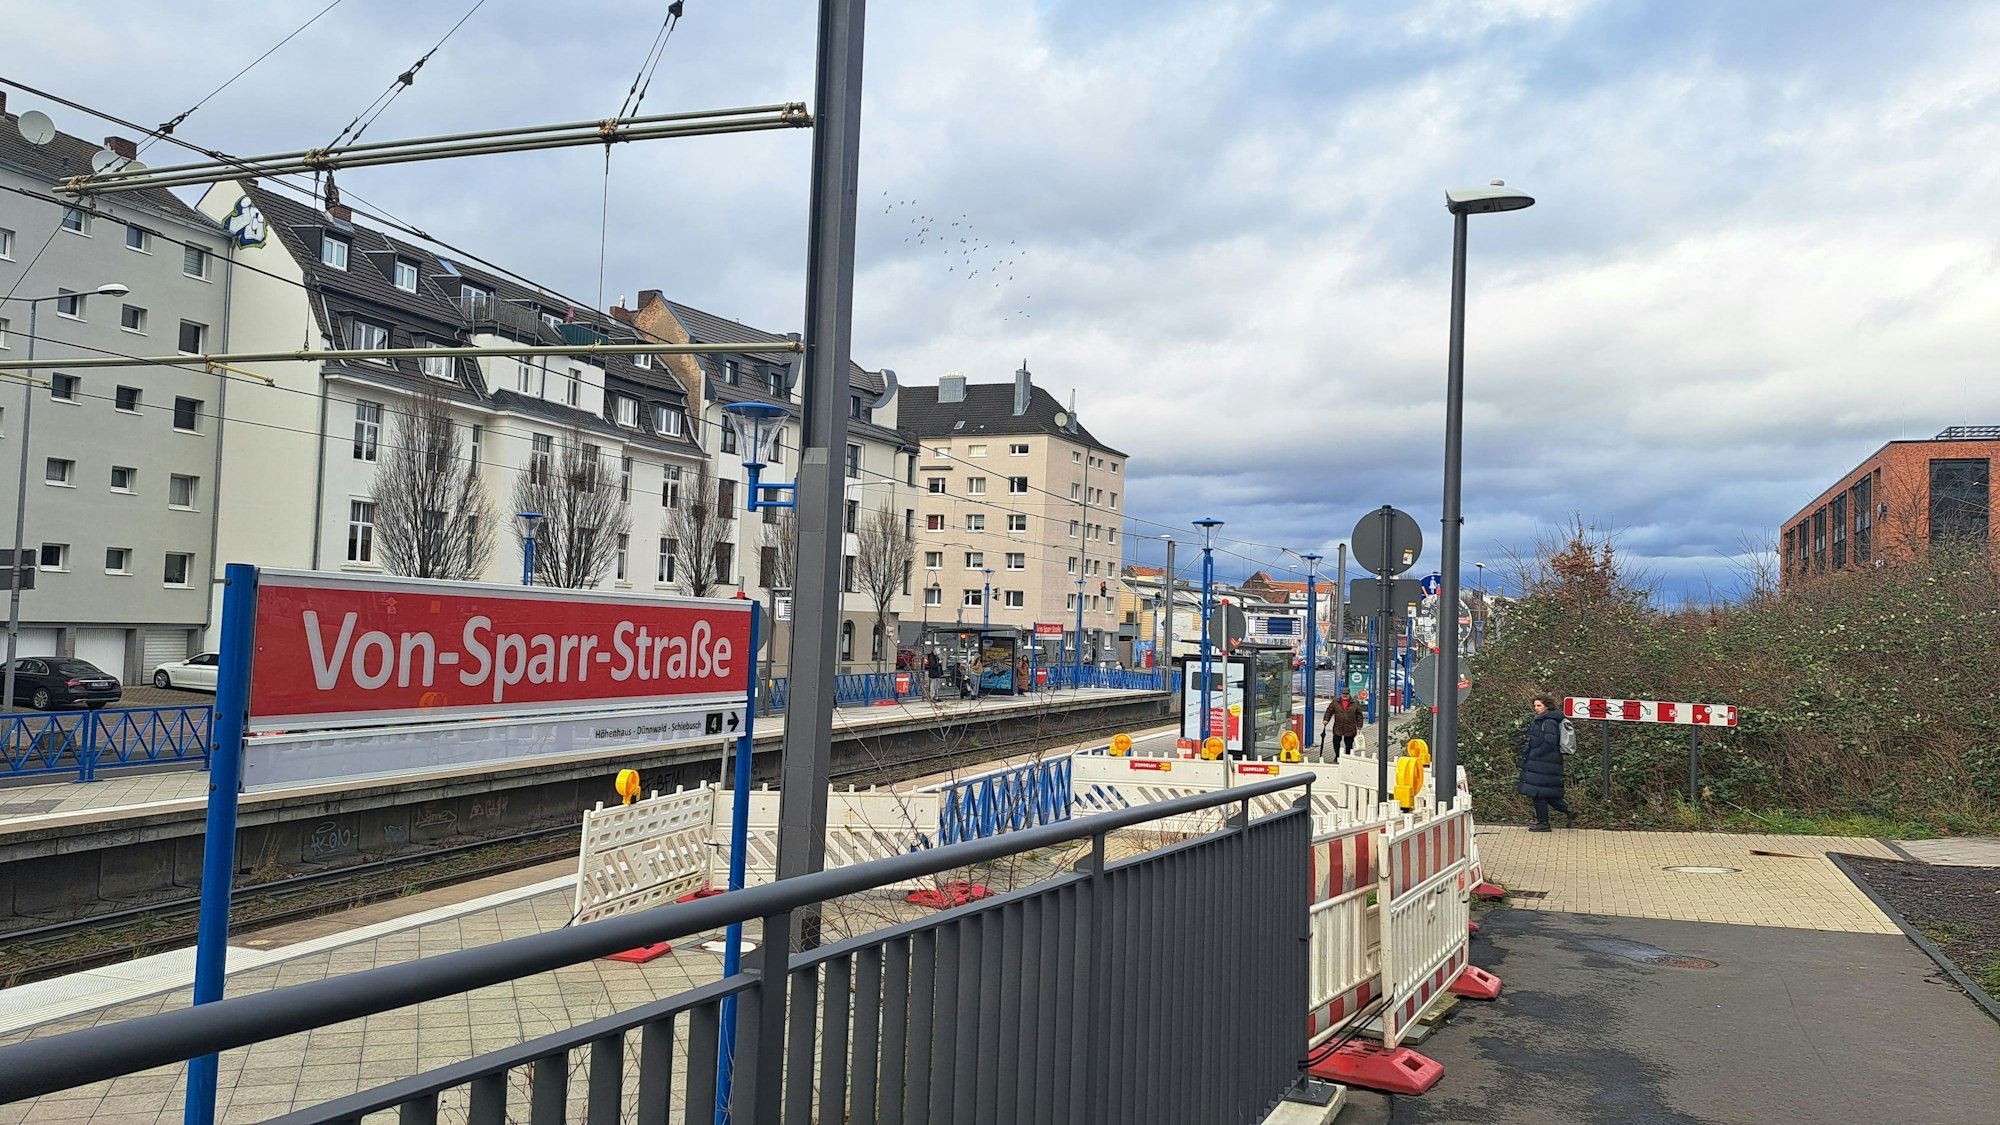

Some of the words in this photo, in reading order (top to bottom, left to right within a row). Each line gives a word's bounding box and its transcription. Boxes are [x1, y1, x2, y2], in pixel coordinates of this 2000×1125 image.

[302, 609, 732, 703] Von-Sparr-Straße
[596, 728, 632, 739] Höhenhaus
[637, 725, 667, 735] Dünnwald
